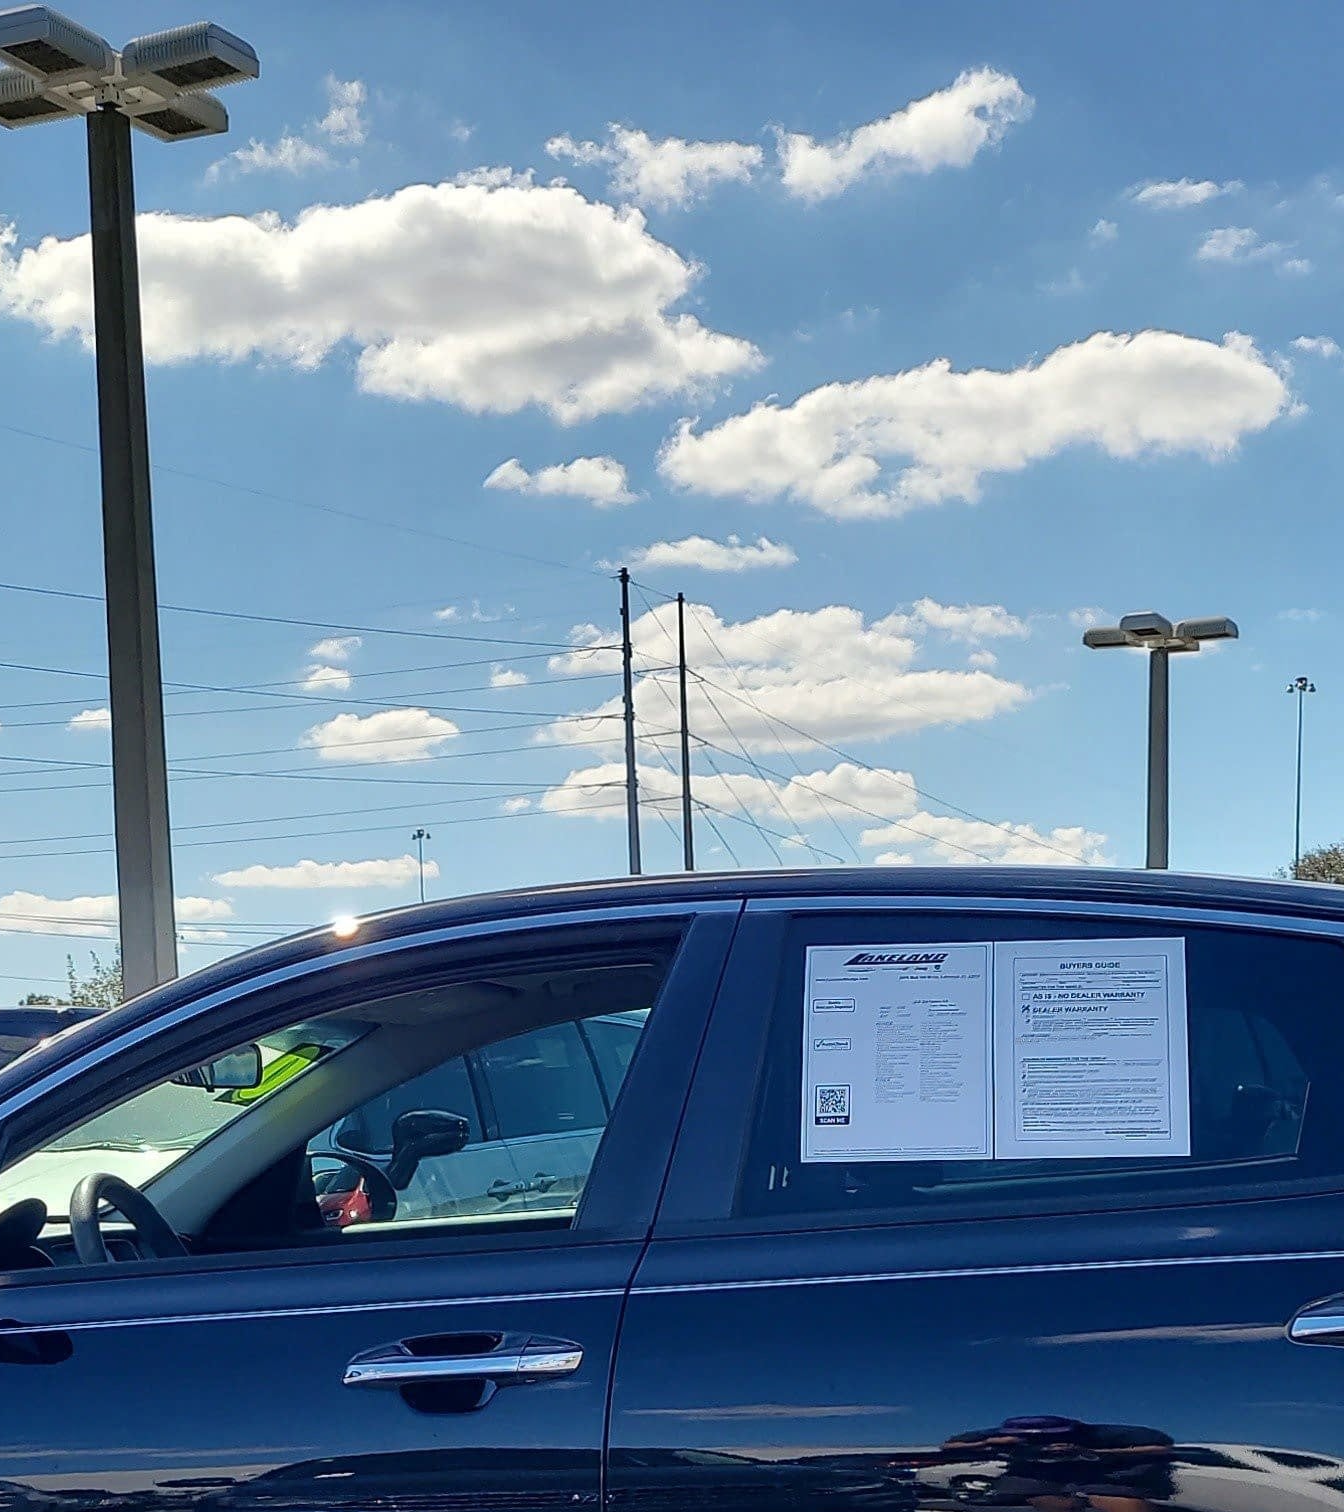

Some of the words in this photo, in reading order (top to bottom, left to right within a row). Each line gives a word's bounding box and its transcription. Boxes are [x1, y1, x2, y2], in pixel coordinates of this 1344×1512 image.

[843, 952, 949, 966] LAKELAND
[1060, 962, 1093, 970] BUYERS
[1095, 961, 1120, 969] GUIDE
